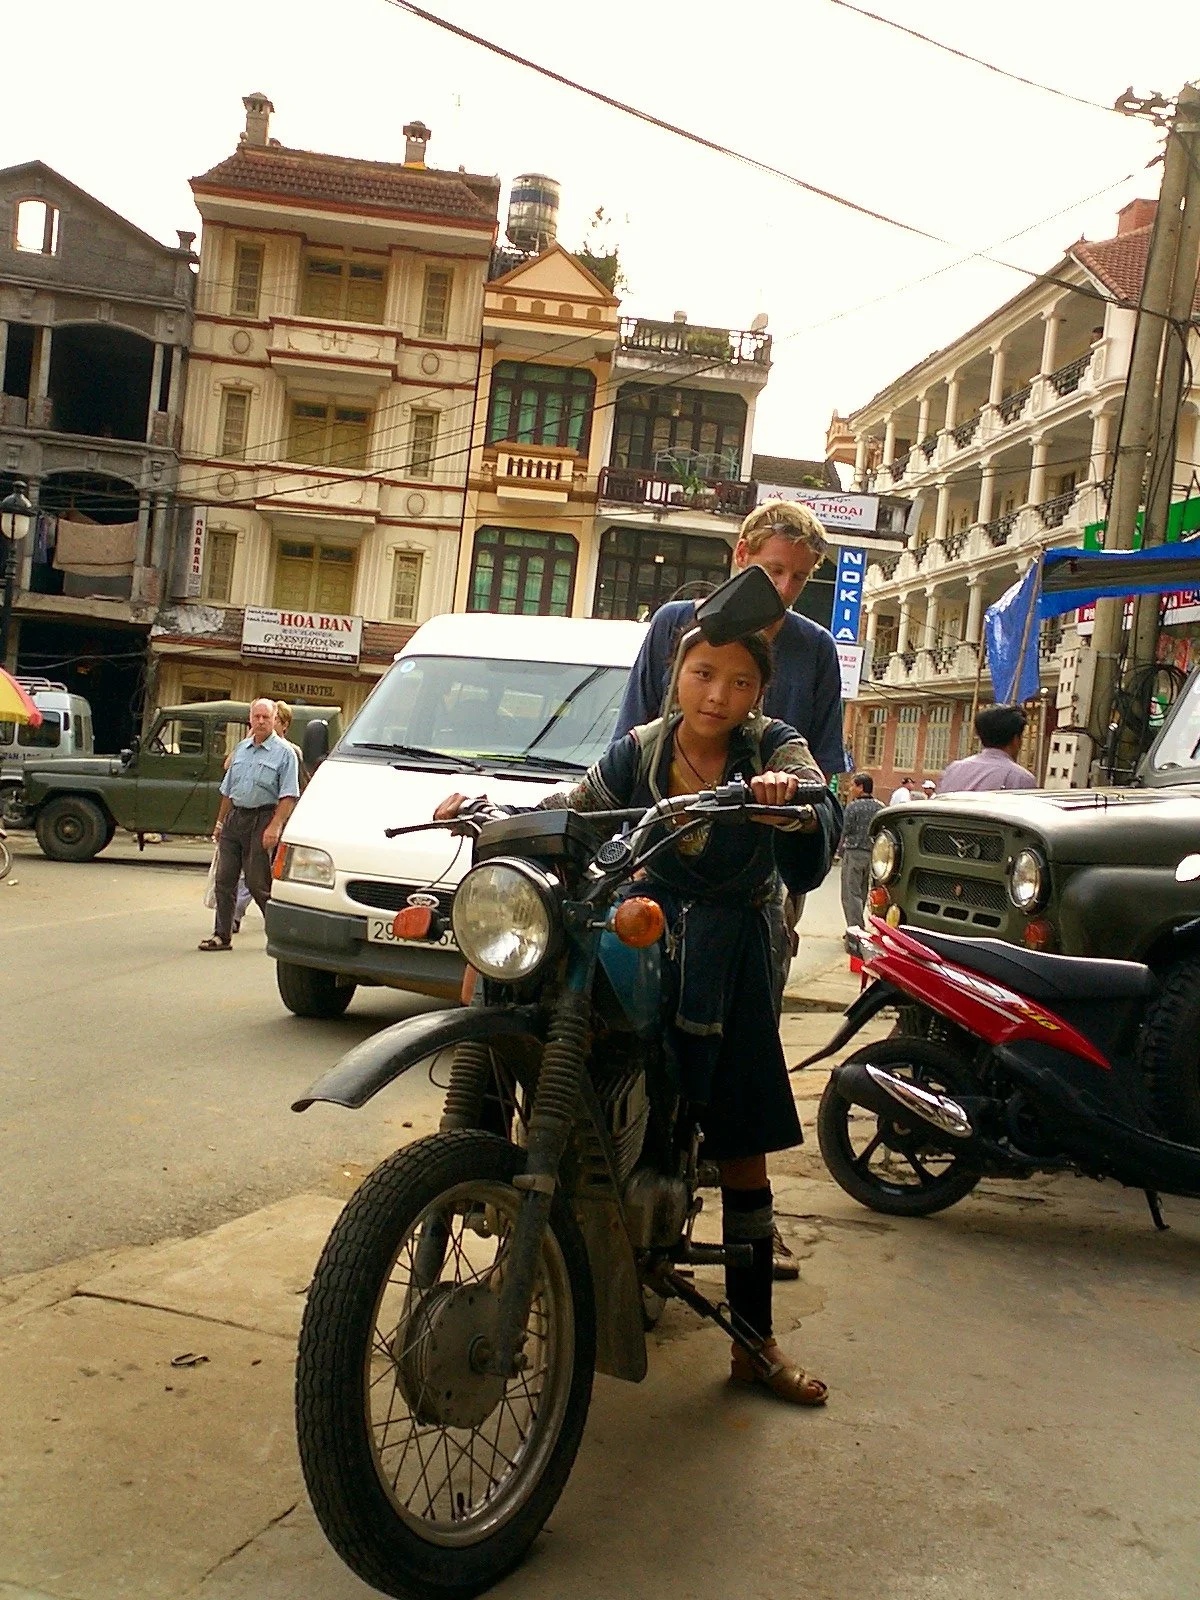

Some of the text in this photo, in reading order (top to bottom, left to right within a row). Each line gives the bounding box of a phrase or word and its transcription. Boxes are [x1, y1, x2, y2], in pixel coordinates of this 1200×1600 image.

[835, 551, 862, 641] NOKIA
[280, 612, 314, 629] HOA
[319, 616, 353, 632] BAN
[272, 681, 335, 697] HOA BAN HOTEL
